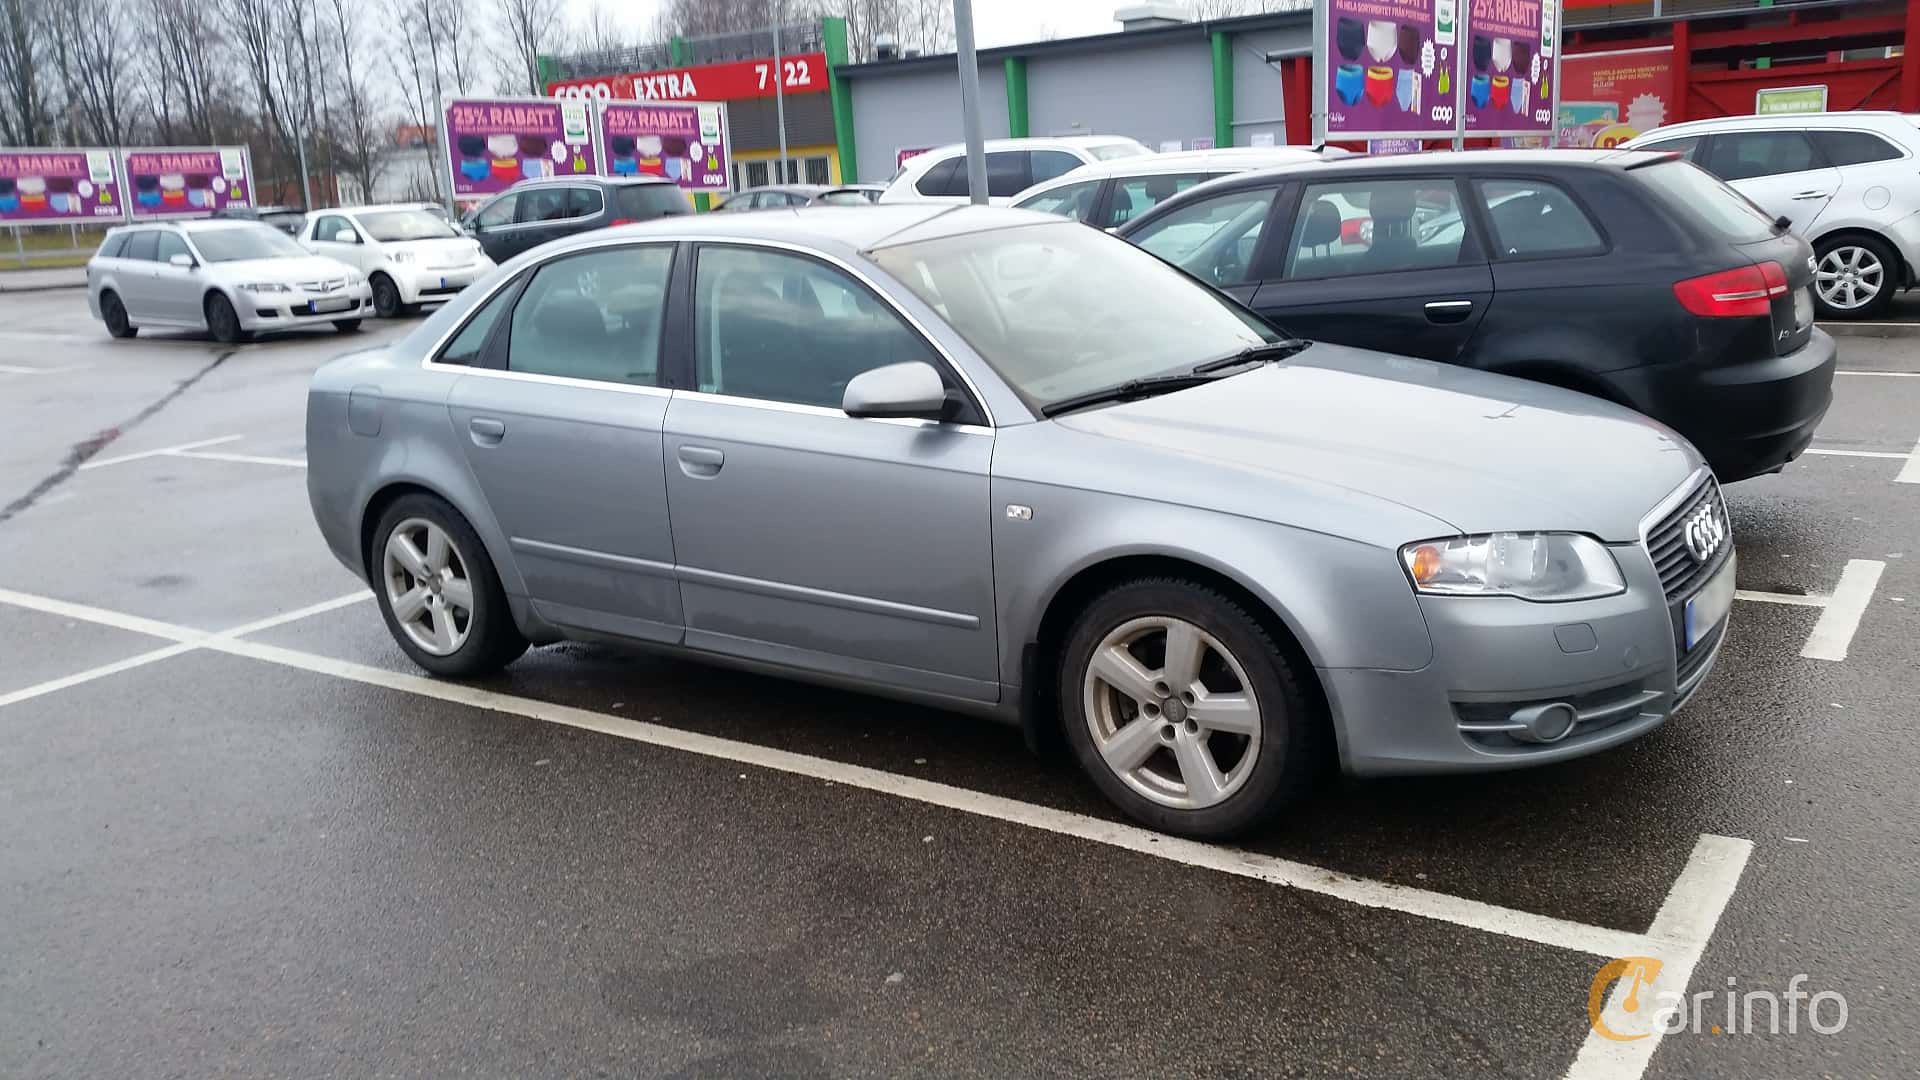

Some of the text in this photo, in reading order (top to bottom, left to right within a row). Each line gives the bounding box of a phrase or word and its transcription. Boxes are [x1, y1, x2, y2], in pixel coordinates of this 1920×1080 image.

[1496, 0, 1539, 27] RABATT
[755, 60, 811, 90] 7 22
[633, 72, 697, 100] EXTRA
[453, 106, 556, 128] 25% RABATT
[607, 110, 694, 128] 25% RABATT
[1431, 105, 1453, 125] coop
[1535, 109, 1551, 125] coop
[702, 174, 723, 186] coop
